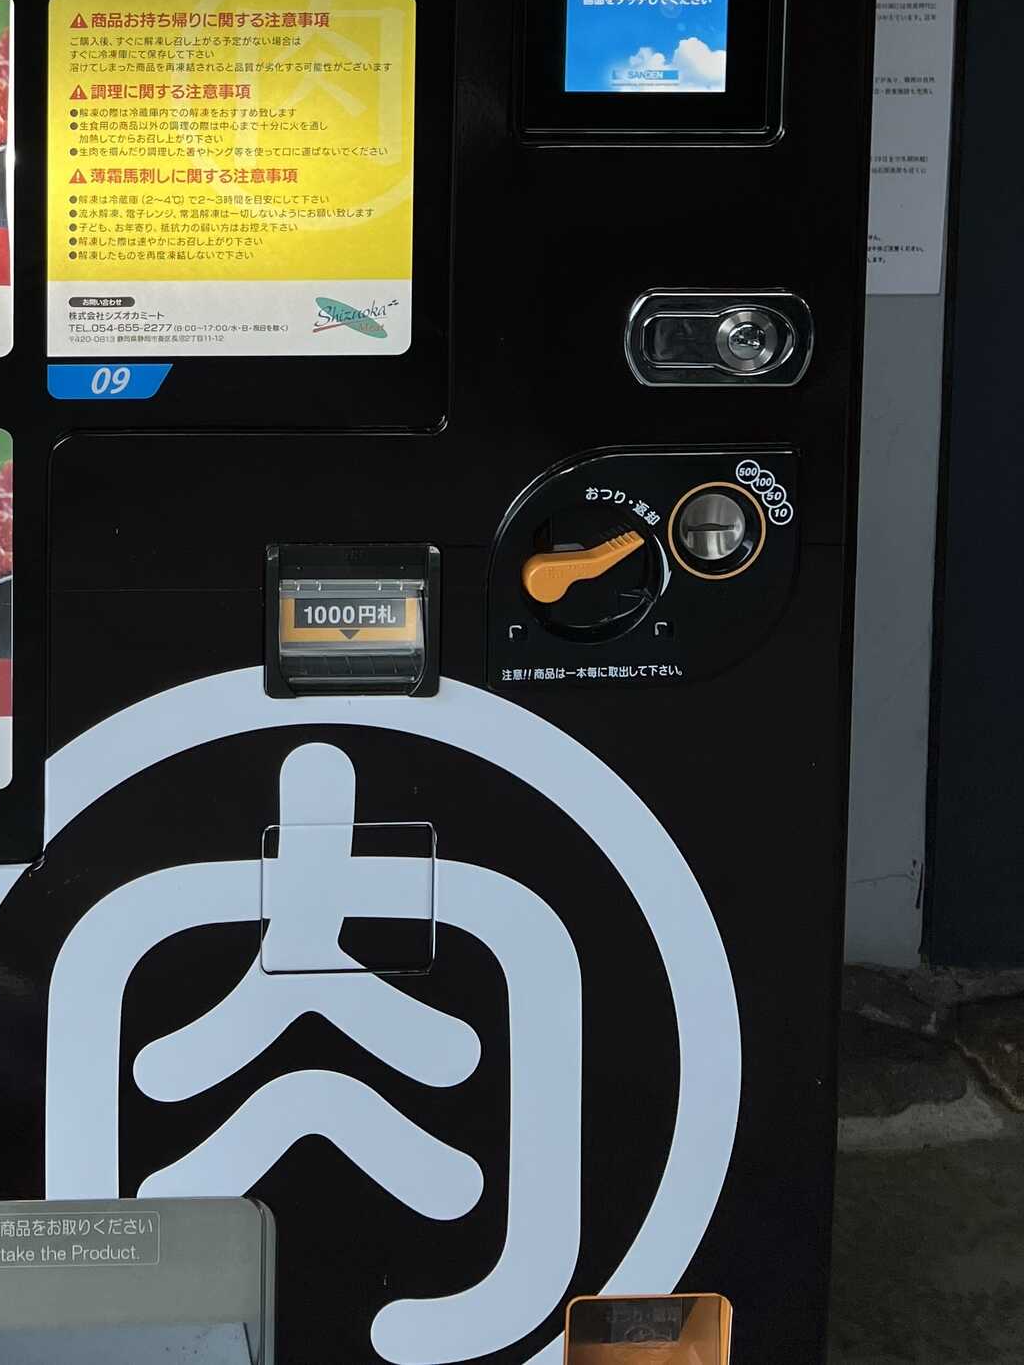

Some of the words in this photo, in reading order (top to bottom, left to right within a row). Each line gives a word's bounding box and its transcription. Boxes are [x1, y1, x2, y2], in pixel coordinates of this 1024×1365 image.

[91, 12, 329, 28] 商品お持ち帰りに関する注意事項
[91, 84, 251, 99] 調理に関する注意事項
[80, 135, 222, 144] 加熱してからお召し上がり下さい
[91, 168, 297, 184] 薄霜馬刺しに関する注意事項
[69, 311, 164, 320] 株式会社シズオカミート
[316, 300, 386, 327] Shizuoka
[91, 367, 130, 394] 09
[739, 468, 757, 477] 500
[755, 477, 772, 486] 100
[766, 491, 782, 500] 50
[585, 486, 660, 526] おつり・返却
[775, 508, 787, 517] 10
[304, 605, 396, 624] 1000円札
[46, 742, 582, 1365] 肉
[0, 1247, 35, 1263] take
[40, 1246, 67, 1262] the
[72, 1245, 140, 1261] Product.
